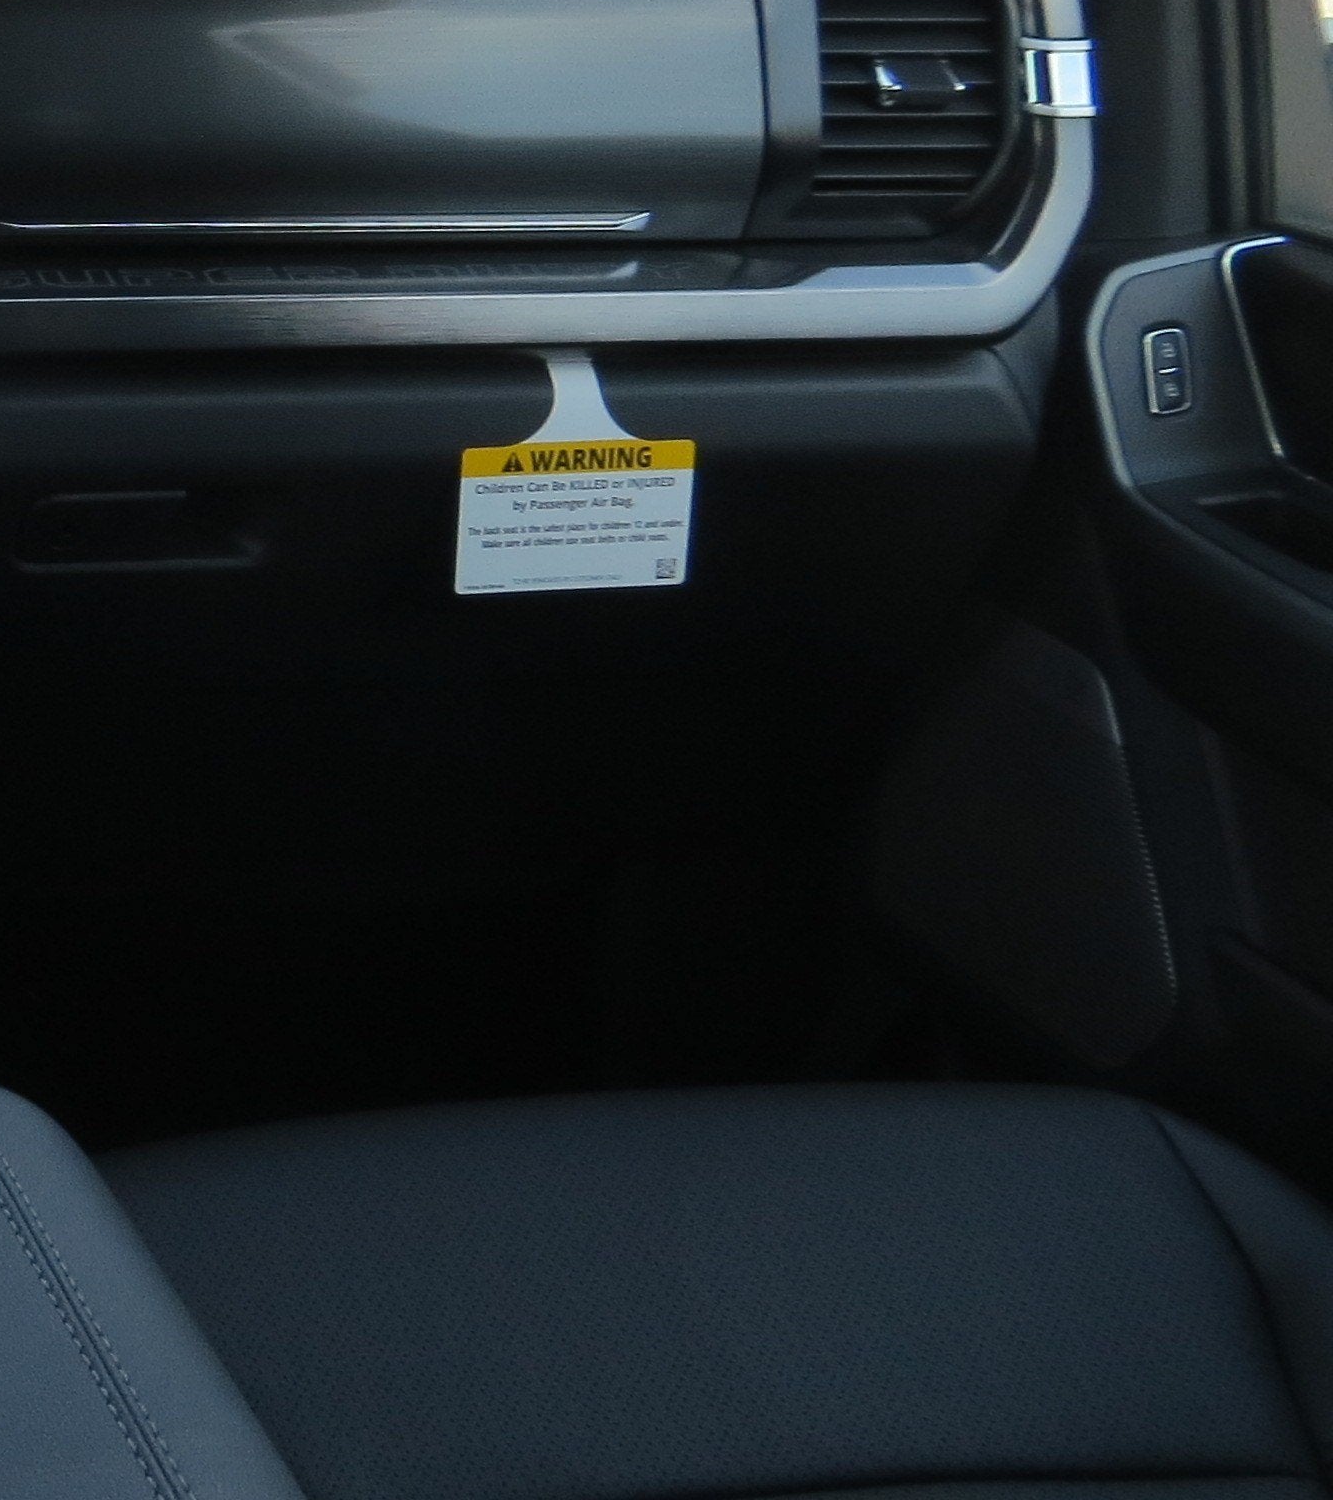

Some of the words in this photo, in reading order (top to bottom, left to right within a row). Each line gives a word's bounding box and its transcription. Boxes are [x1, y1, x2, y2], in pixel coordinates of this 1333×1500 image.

[530, 446, 652, 472] WARNING
[476, 483, 524, 495] Children
[527, 482, 549, 492] Can
[552, 481, 566, 491] Be
[570, 479, 608, 491] KILLED
[612, 480, 624, 489] or
[627, 476, 675, 490] INJURED
[513, 501, 527, 514] by
[530, 500, 587, 512] Passenger
[591, 498, 609, 508] Air
